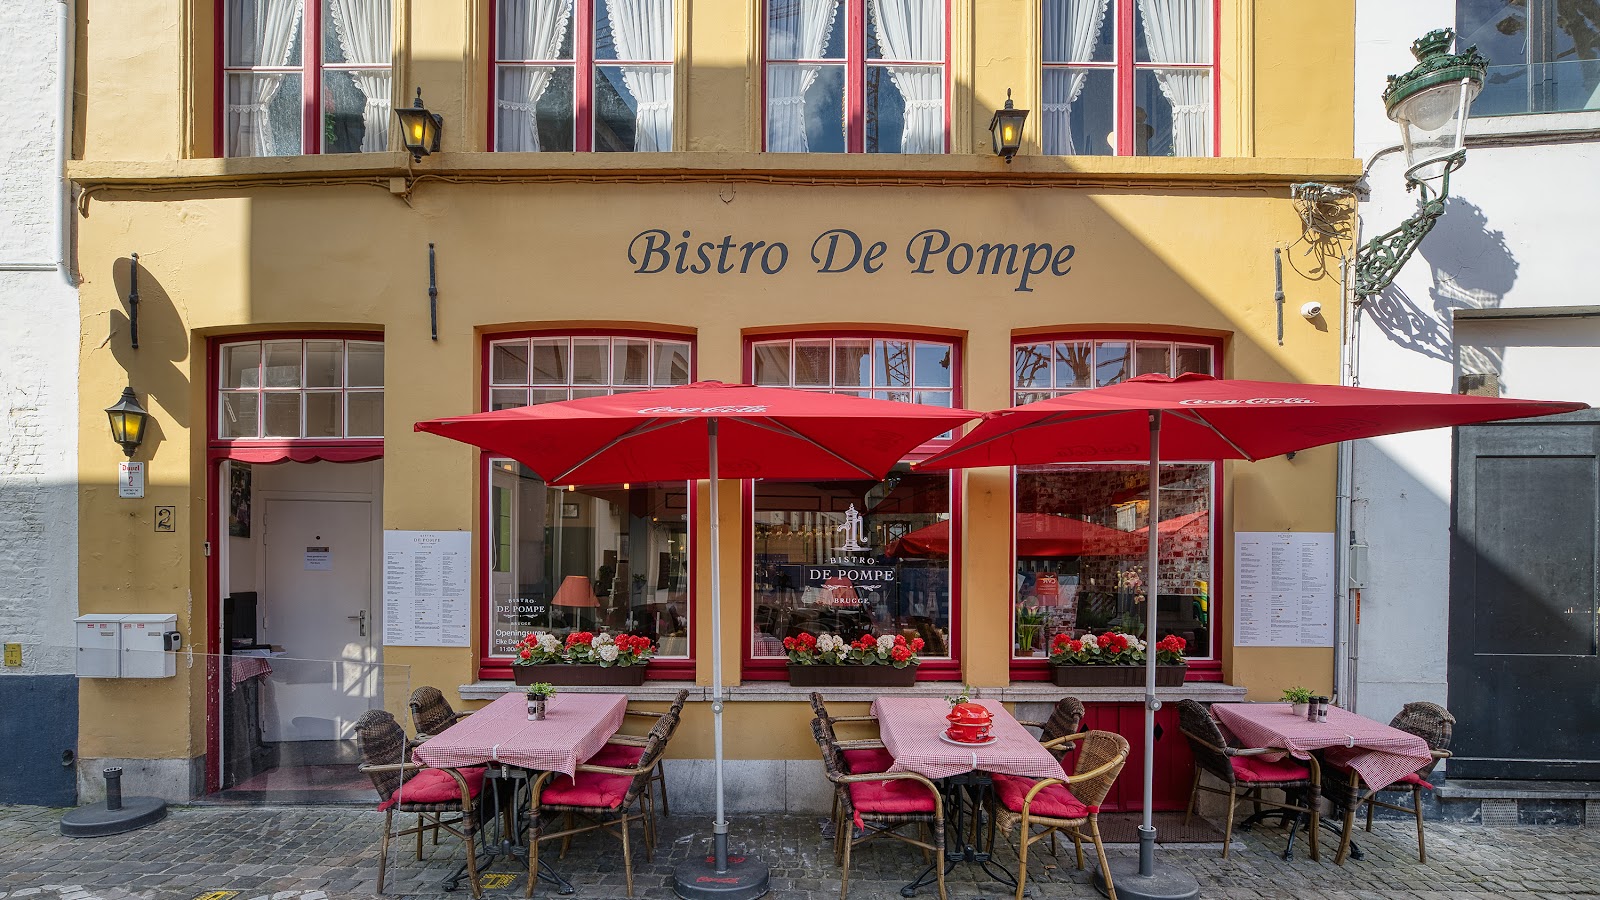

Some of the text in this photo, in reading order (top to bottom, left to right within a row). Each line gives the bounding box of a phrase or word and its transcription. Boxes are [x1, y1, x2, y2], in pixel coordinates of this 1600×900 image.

[627, 229, 1075, 292] Bistro De Pompe
[128, 475, 134, 487] 2
[158, 508, 172, 530] 2
[829, 556, 875, 565] BISTRO
[809, 569, 895, 581] DE POMPE
